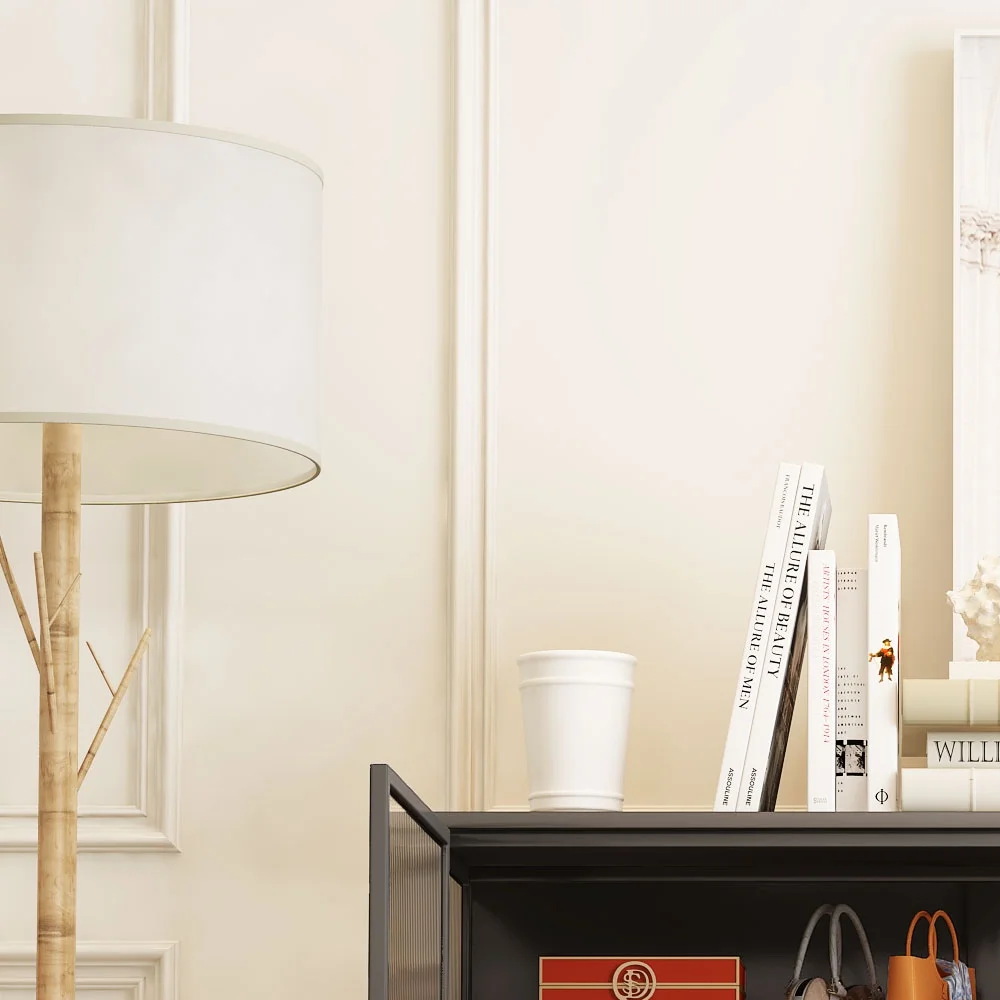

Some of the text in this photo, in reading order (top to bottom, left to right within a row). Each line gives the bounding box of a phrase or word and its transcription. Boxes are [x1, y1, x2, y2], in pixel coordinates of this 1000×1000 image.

[768, 484, 815, 679] THE ALLURE OF BEAUTY
[738, 562, 776, 710] THE ALLURE OF MEN
[722, 767, 734, 806] ASSOULINE
[745, 767, 757, 806] ASSOULINE
